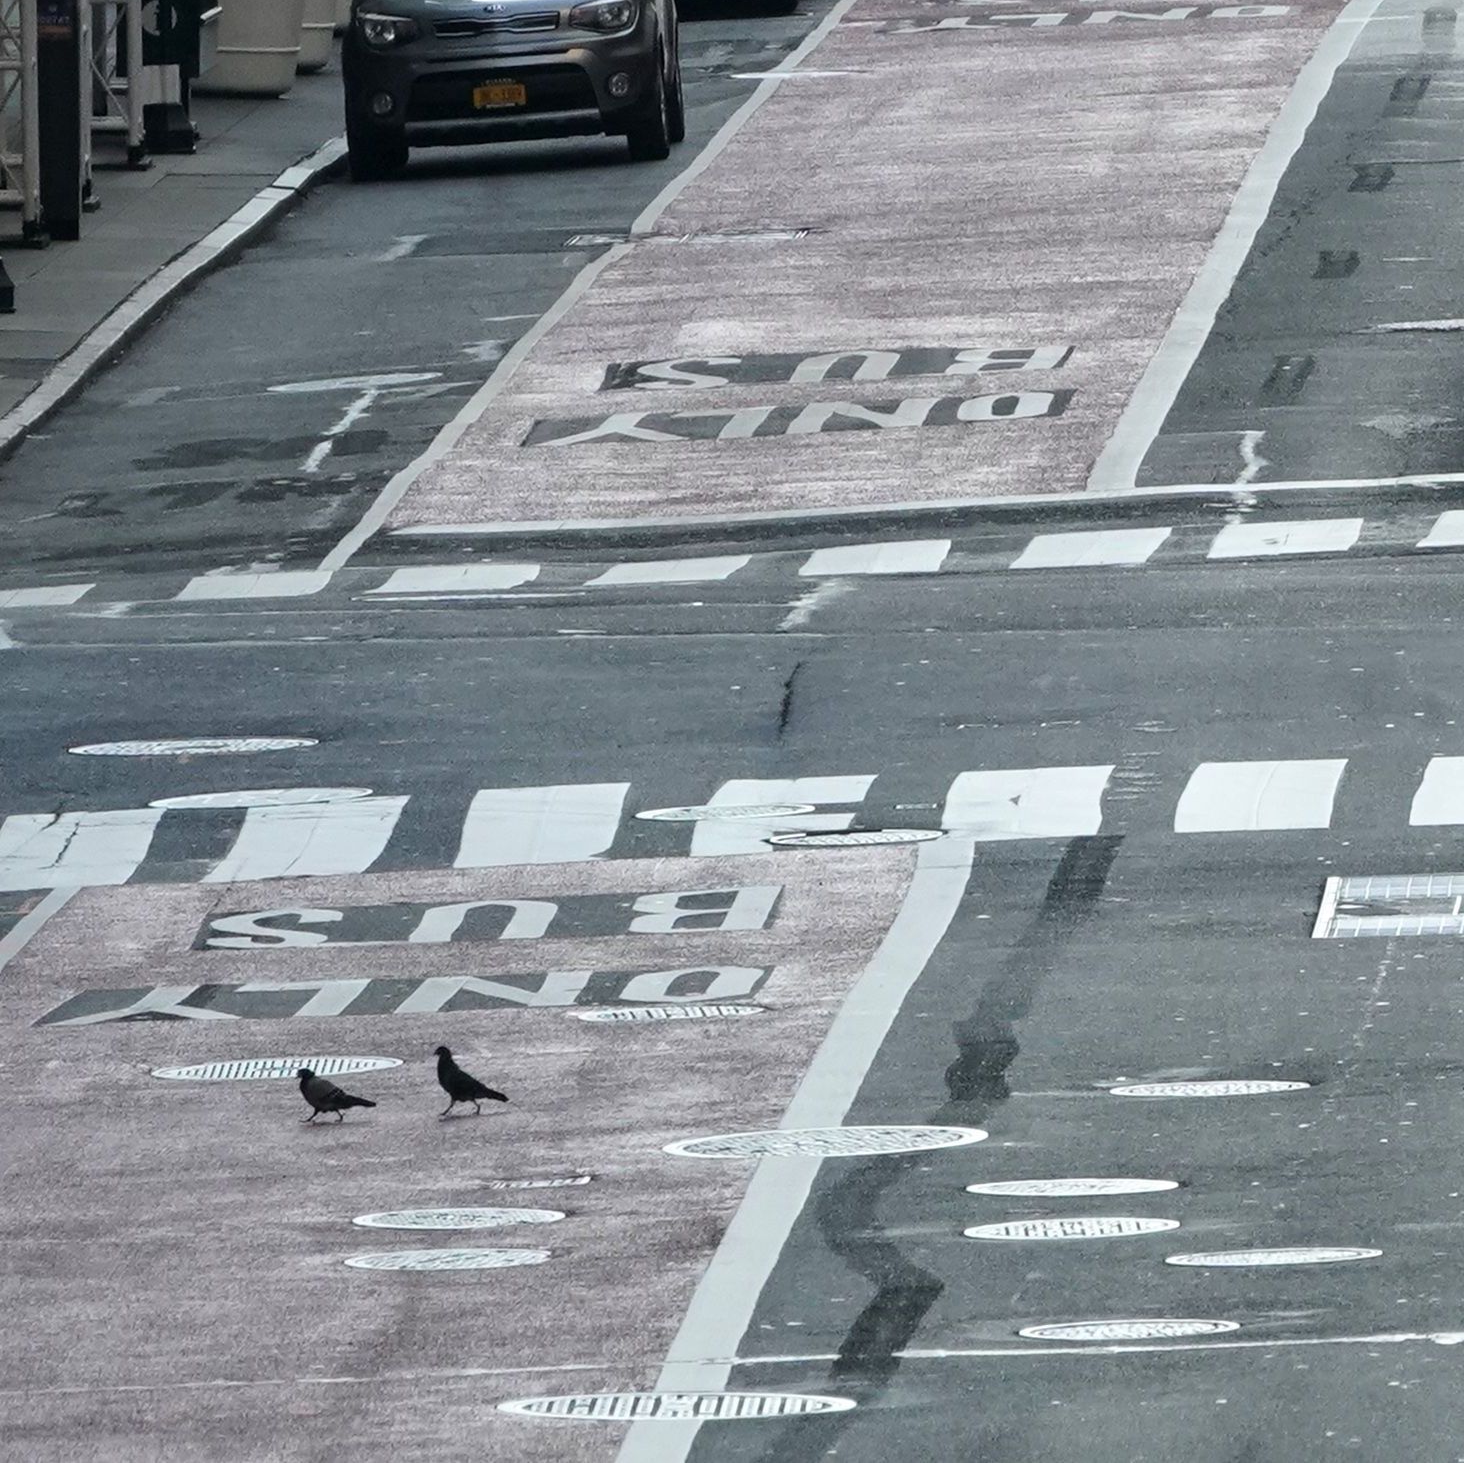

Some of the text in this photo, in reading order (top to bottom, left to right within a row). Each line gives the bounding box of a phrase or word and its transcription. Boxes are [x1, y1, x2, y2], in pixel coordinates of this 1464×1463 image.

[632, 345, 1067, 390] BUS
[535, 391, 1056, 448] ONLY
[206, 885, 784, 949] BUS
[50, 966, 768, 1026] ONLY
